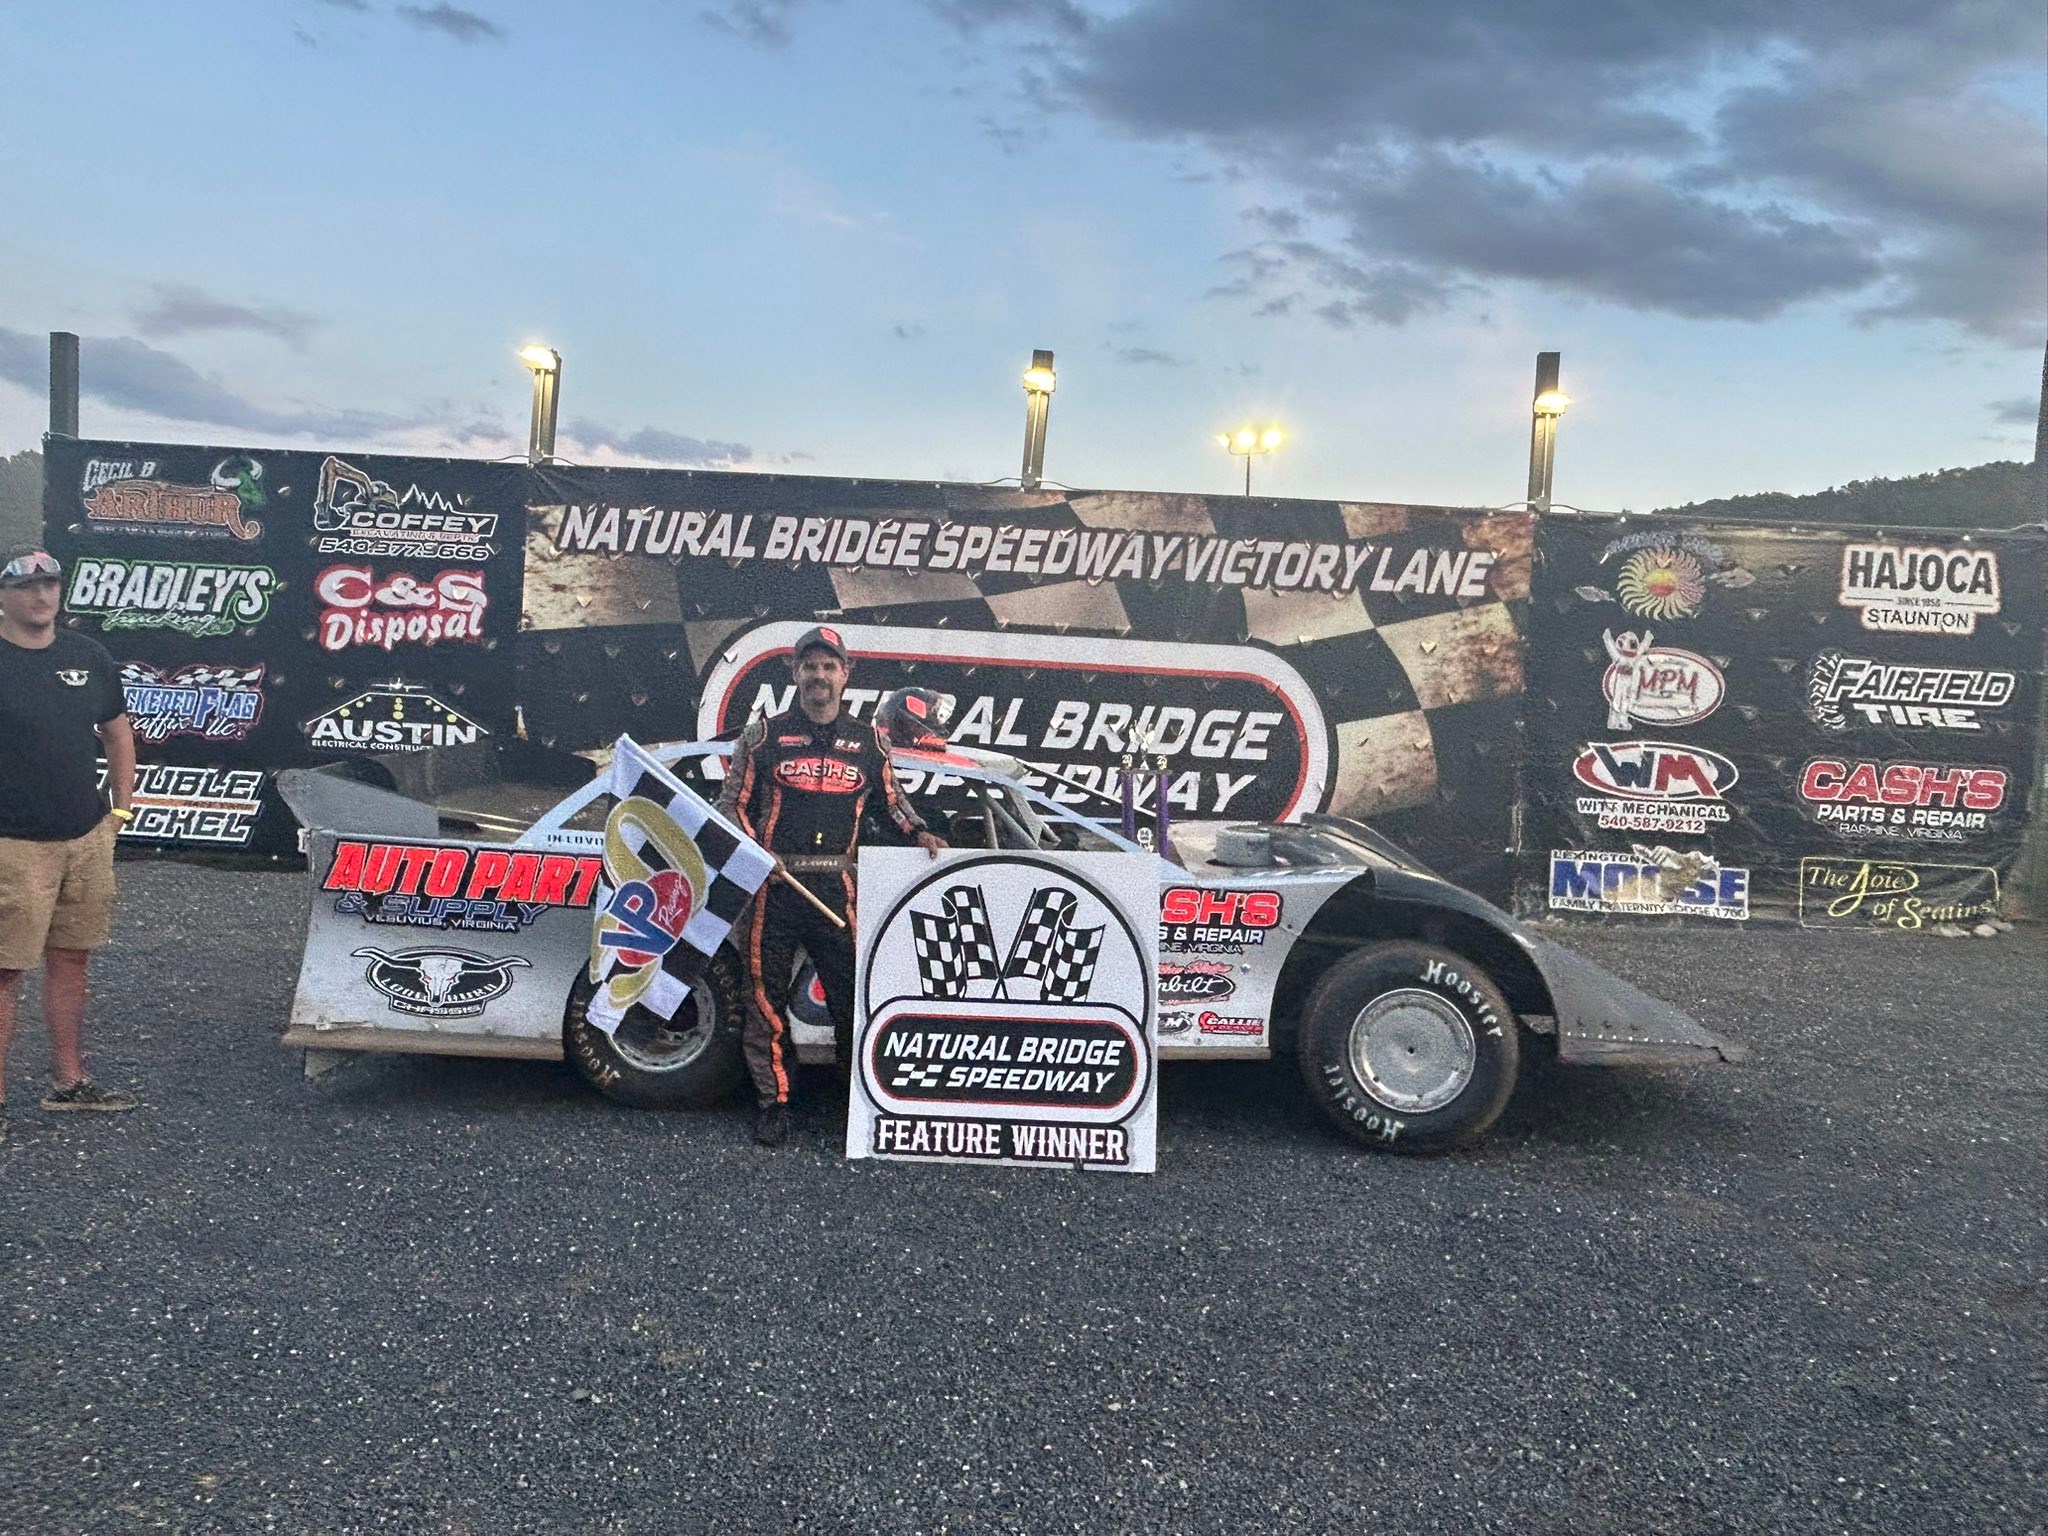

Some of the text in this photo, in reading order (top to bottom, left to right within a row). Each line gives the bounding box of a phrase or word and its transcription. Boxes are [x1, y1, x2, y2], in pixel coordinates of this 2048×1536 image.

[83, 460, 157, 491] CECIL B
[351, 512, 492, 533] COFFEY
[560, 505, 1496, 598] NATURAL BRIDGE SPEEDWAY VICTORY LANE
[70, 562, 269, 615] BRADLEY'S
[1849, 550, 1993, 595] HAJOCA
[325, 602, 482, 650] Disposal
[1867, 608, 1969, 628] STAUNTON
[1636, 665, 1699, 705] MPM
[1824, 658, 2015, 706] FAIRFIELD
[194, 687, 259, 728] FLAG
[1853, 703, 1982, 739] TIRE
[311, 718, 477, 747] AUSTIN
[311, 739, 434, 752] ELECTRICAL CONSTRUC
[1041, 700, 1283, 761] BRIDGE
[1802, 760, 2007, 810] CASH'S
[118, 804, 257, 842] ICKEL
[1600, 814, 1704, 831] 540-587-9212
[1622, 802, 1729, 820] MECHANICAL
[1817, 803, 1986, 829] PARTS & REPAIR
[324, 842, 468, 896] AUTO
[1552, 850, 1641, 864] LEXINGTON
[1808, 866, 1849, 887] The
[335, 893, 548, 925] & SUPPLY
[598, 880, 678, 955] VP
[1552, 897, 1596, 911] FAMILY
[1599, 900, 1666, 913] FRTERNITY
[1873, 897, 1898, 921] of
[451, 918, 516, 931] VIRGINIA
[1173, 927, 1188, 941] &
[1193, 927, 1264, 944] REPAIR
[884, 1030, 1127, 1066] NATURAL BRIDGE
[946, 1066, 1116, 1093] SPEEDWAY
[878, 1117, 1126, 1161] FEATURE WINNER
